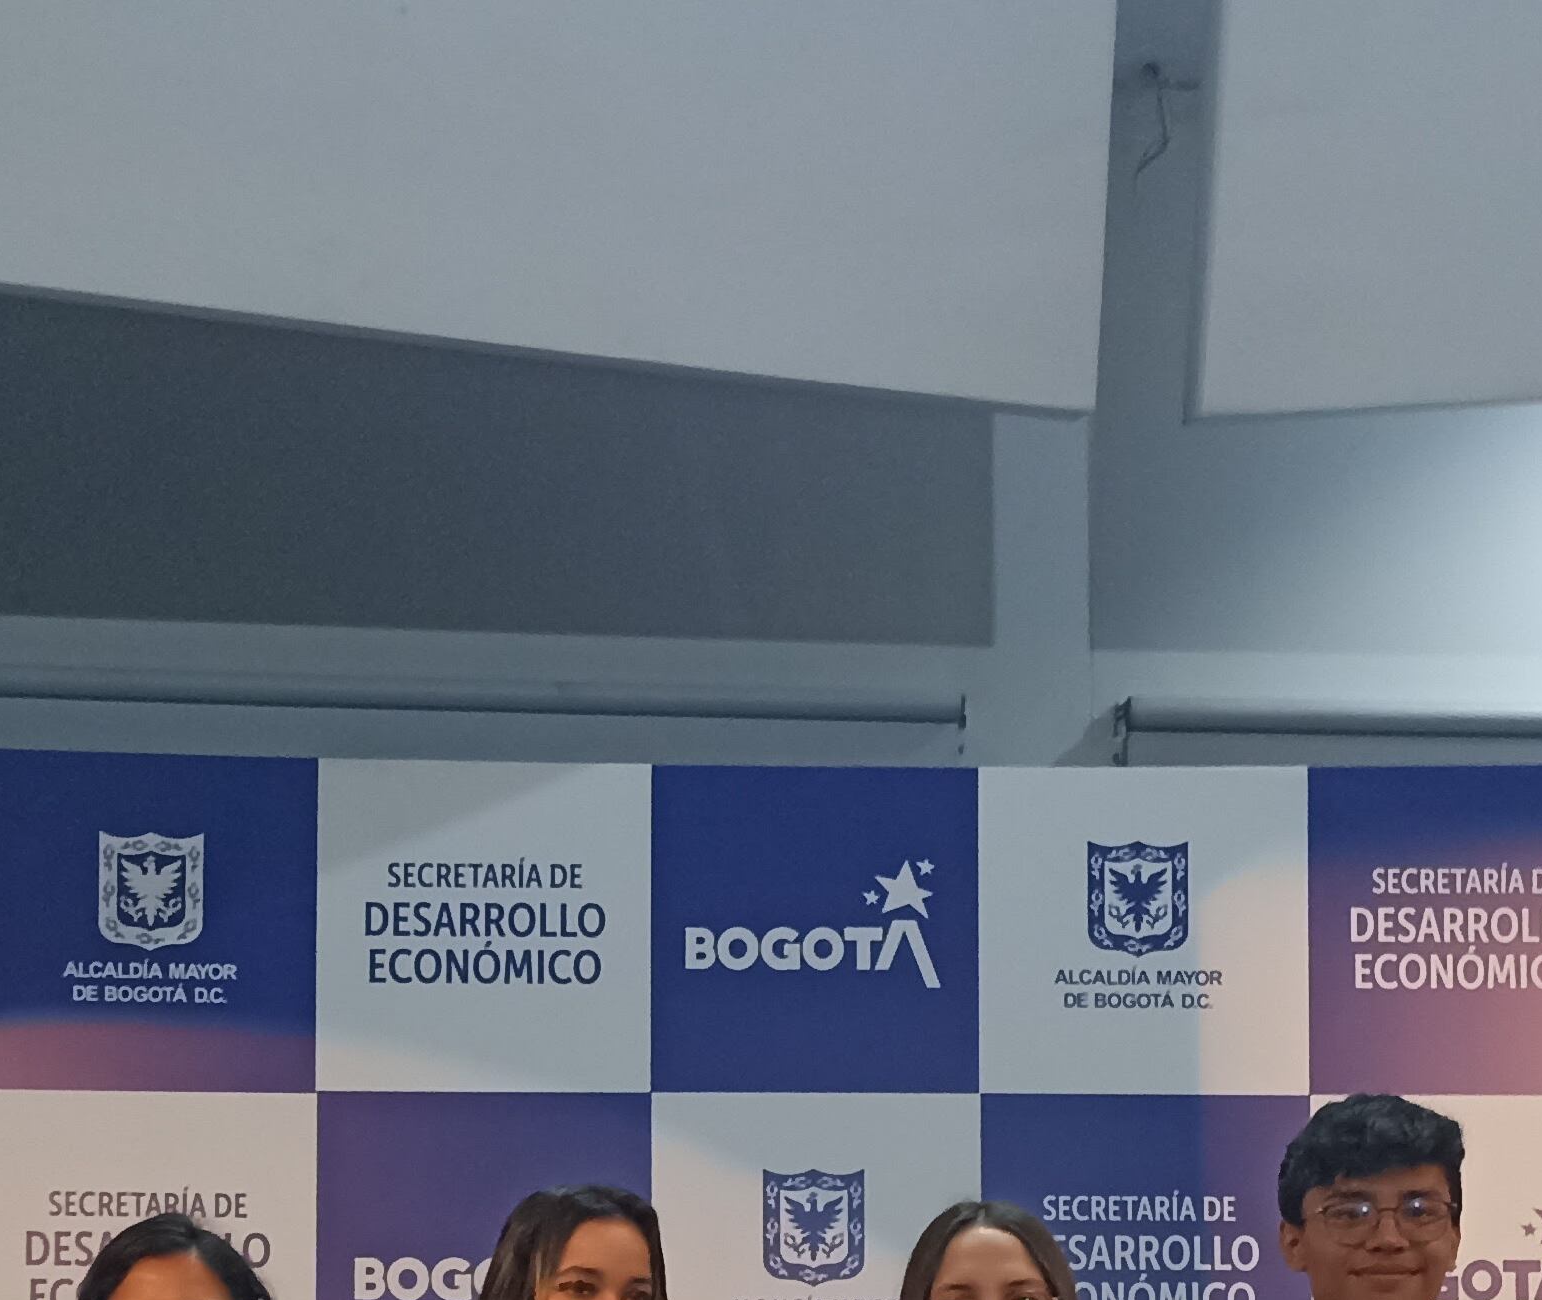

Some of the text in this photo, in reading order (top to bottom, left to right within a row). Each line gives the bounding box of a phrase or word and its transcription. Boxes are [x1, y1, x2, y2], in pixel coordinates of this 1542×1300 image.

[388, 857, 583, 889] SECRETARÍA DE
[1372, 862, 1524, 895] SECRETARÍA
[365, 901, 606, 939] DESARROLLO
[64, 959, 238, 982] ALCALDÍA MAYOR
[368, 941, 601, 985] ECONÓMICO
[1055, 964, 1223, 986] ALCALDÍA MAYOR
[73, 985, 98, 1002] DE
[104, 981, 187, 1003] BOGOTÁ
[1064, 990, 1089, 1009] DE
[1094, 988, 1175, 1009] BOGOTÁ
[48, 1187, 248, 1219] SECRETARÍA DE
[1042, 1189, 1236, 1222] SECRETARÍA DE
[1053, 1235, 1260, 1272] SARROLLO
